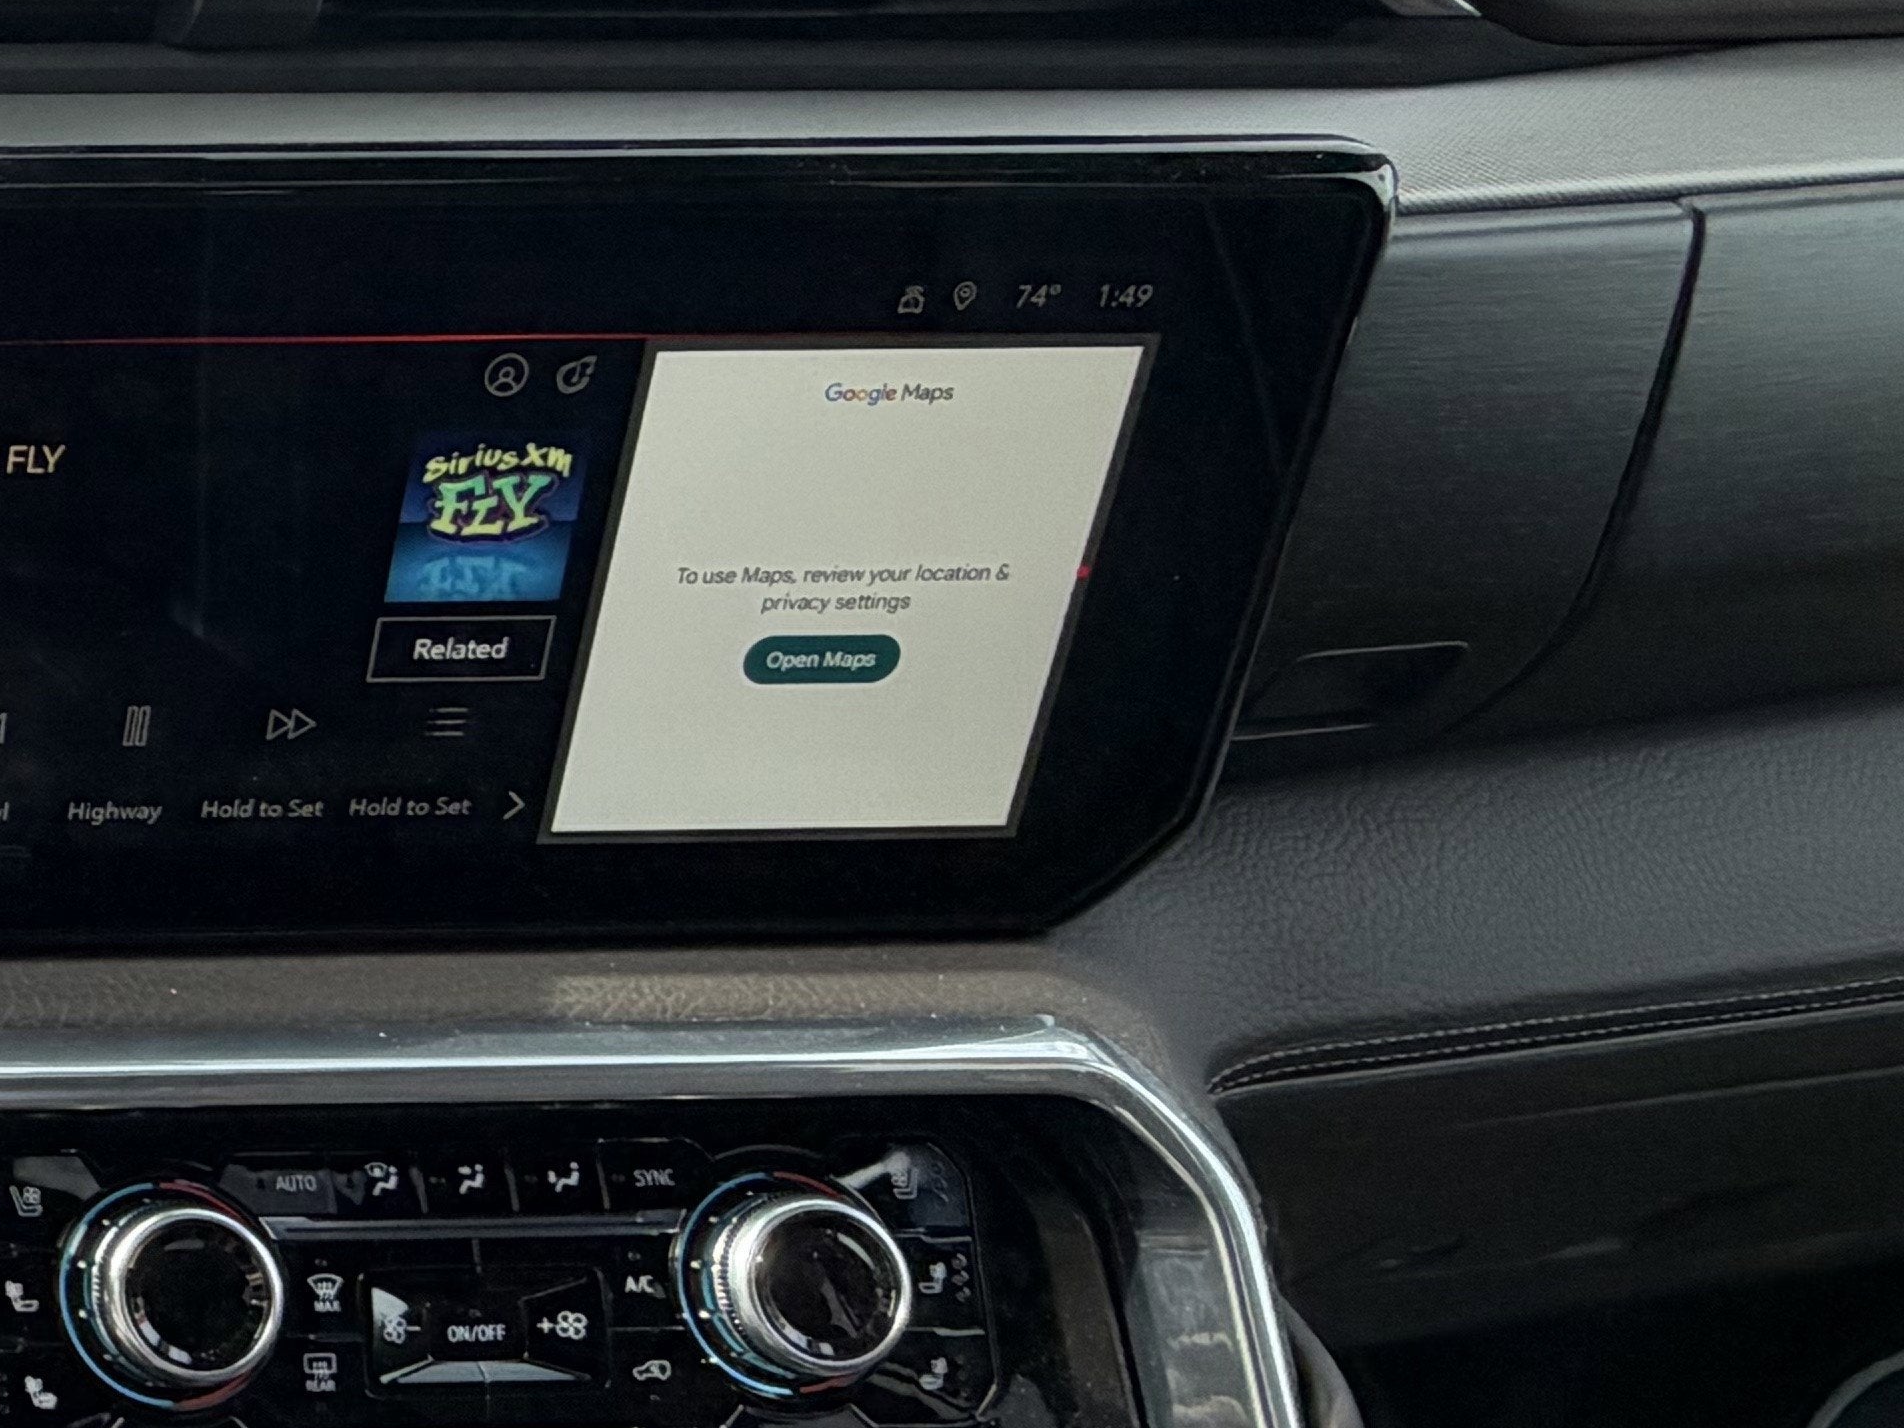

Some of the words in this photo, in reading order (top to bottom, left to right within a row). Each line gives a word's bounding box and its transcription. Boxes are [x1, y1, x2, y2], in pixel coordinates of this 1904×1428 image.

[1015, 284, 1062, 309] 74°
[1099, 284, 1154, 308] 1:49
[824, 382, 898, 406] Google
[901, 383, 954, 405] Maps
[6, 444, 67, 475] FLY
[428, 473, 553, 536] FLY
[678, 566, 699, 584] To
[702, 569, 736, 585] use
[802, 566, 865, 583] review
[868, 567, 911, 588] your
[914, 564, 990, 582] location
[995, 564, 1011, 581] &
[760, 593, 830, 614] privacy
[835, 593, 912, 614] settings
[412, 636, 510, 661] Related
[766, 651, 819, 673] Open
[823, 650, 876, 672] Maps
[67, 801, 163, 826] Highway
[201, 798, 254, 819] Hold
[259, 800, 283, 818] to
[288, 799, 324, 819] Set
[349, 796, 400, 817] Hold
[406, 799, 430, 816] to
[435, 797, 472, 817] Set
[275, 1174, 317, 1193] AUTO
[633, 1168, 675, 1187] SYNC
[625, 1275, 654, 1294] A/C
[446, 1323, 507, 1343] ON/OFF
